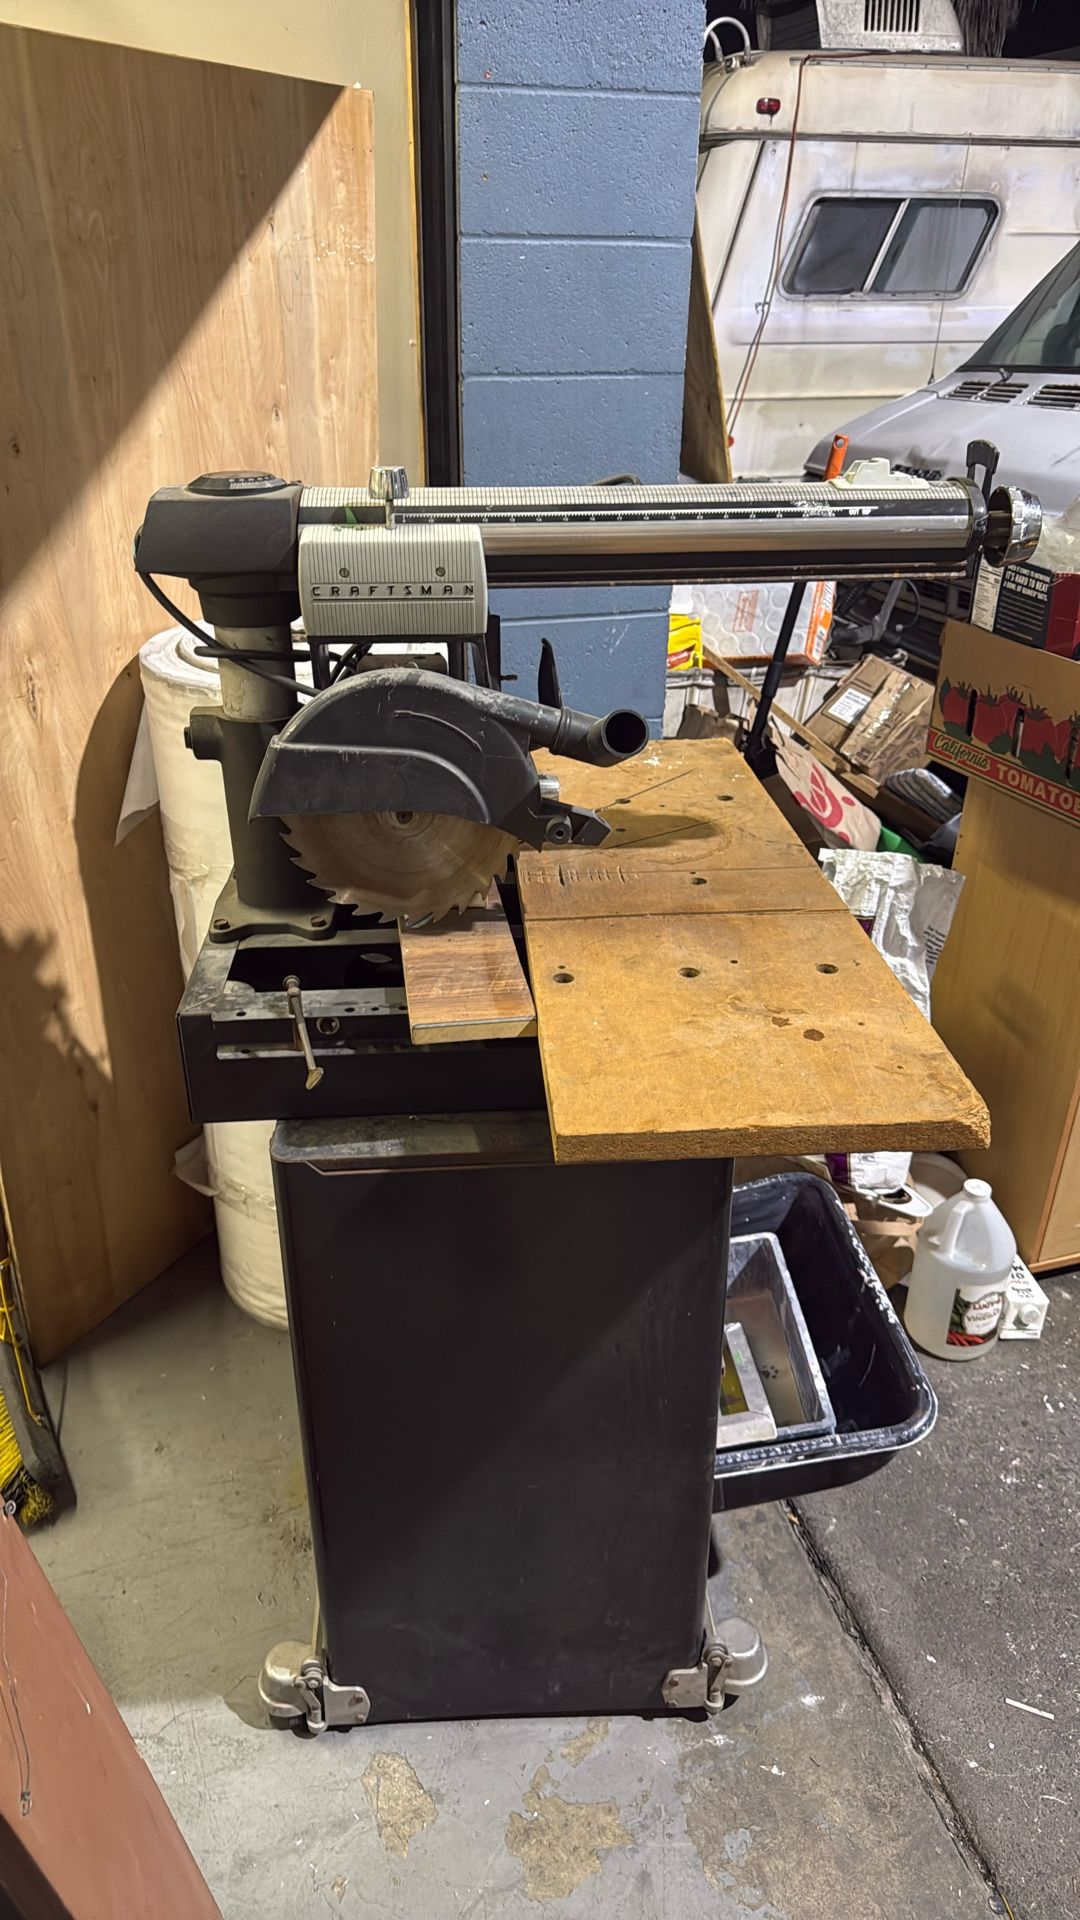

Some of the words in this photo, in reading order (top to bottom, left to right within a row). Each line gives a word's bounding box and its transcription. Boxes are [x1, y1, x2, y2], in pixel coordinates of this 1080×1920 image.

[312, 585, 474, 597] CRAFTSMAN
[1005, 571, 1015, 581] IT'S
[1015, 575, 1028, 586] HARD
[1029, 578, 1036, 588] TO
[1035, 581, 1049, 593] BEAT
[934, 735, 989, 768] California
